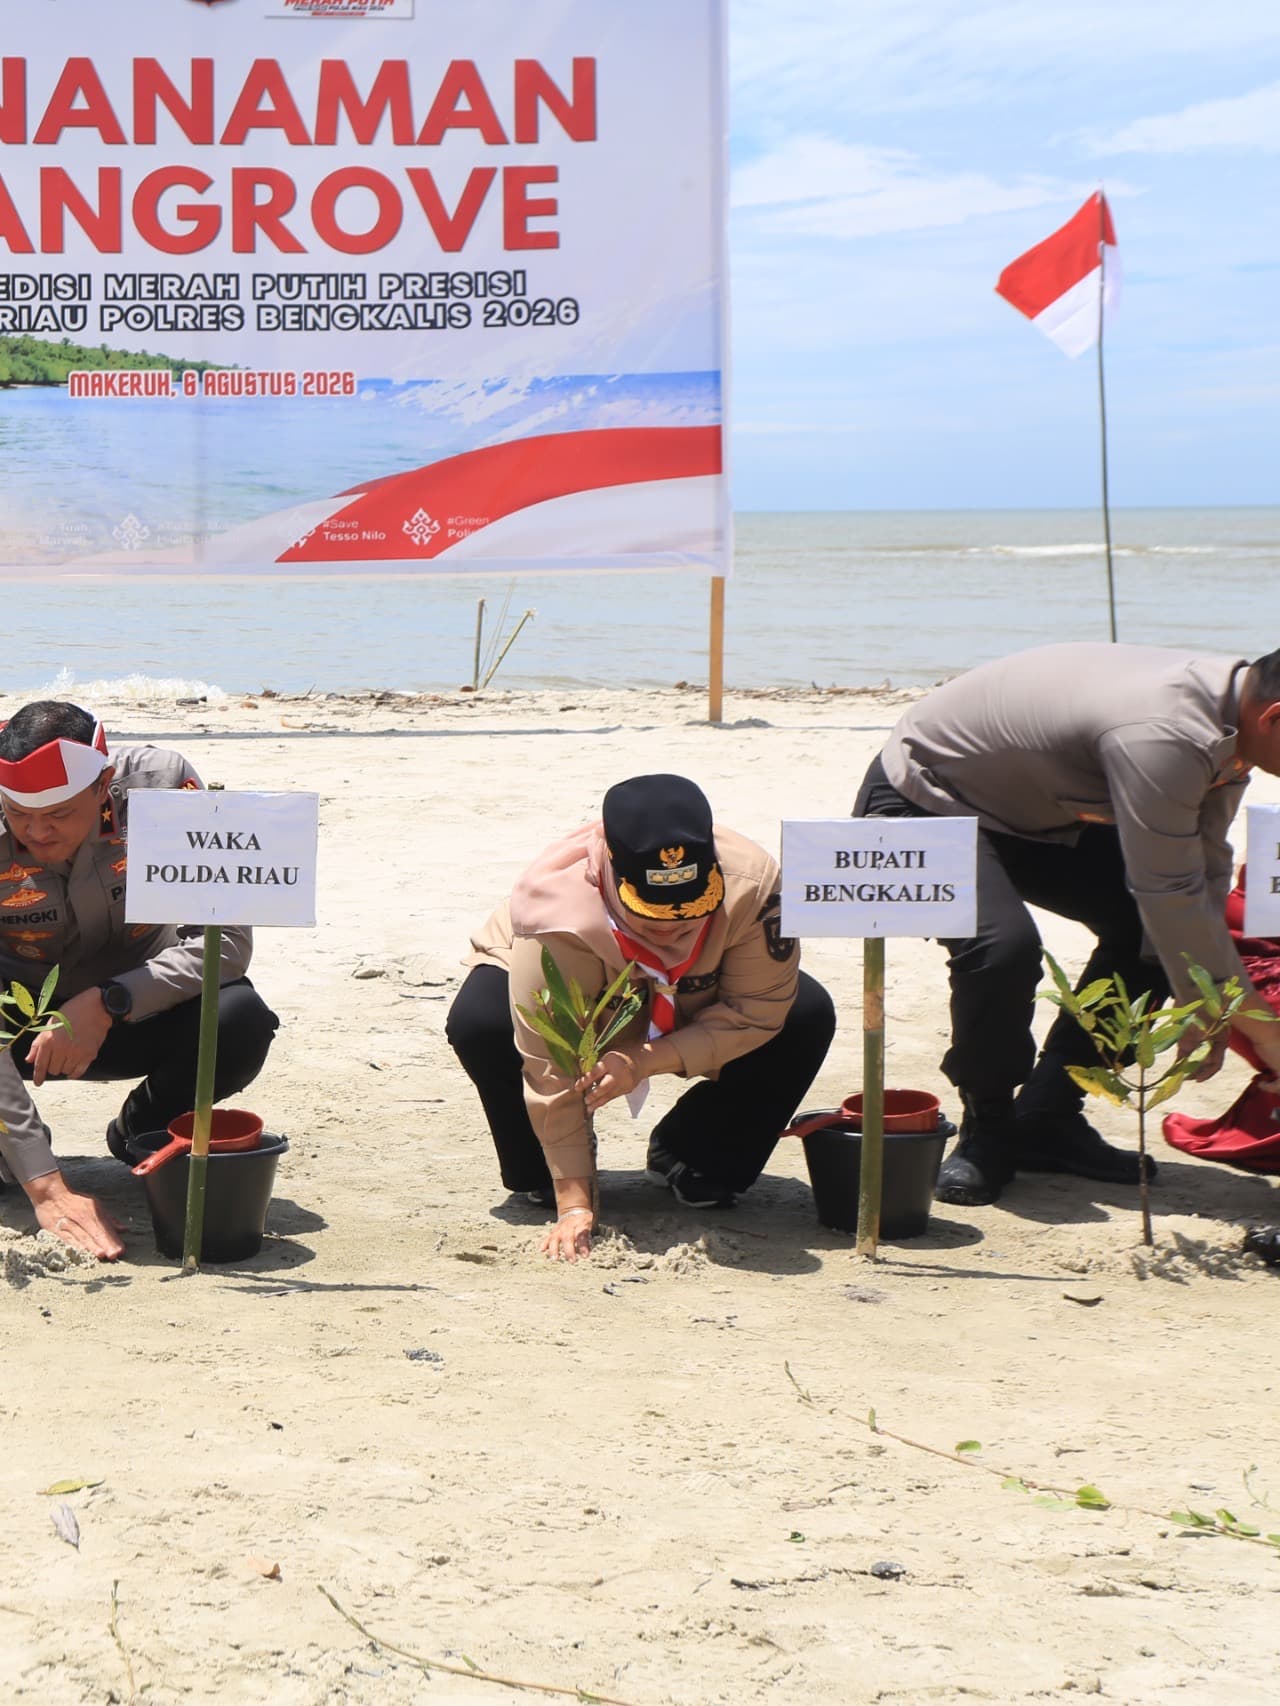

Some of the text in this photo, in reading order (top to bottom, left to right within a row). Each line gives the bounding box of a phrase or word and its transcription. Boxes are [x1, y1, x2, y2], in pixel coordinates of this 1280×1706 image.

[103, 273, 240, 300] MERAH
[252, 273, 367, 300] PUTIH
[379, 270, 527, 299] PRESISI
[100, 304, 245, 332] POLRES
[256, 302, 472, 331] BENGKALIS
[483, 298, 580, 327] 2026
[69, 371, 356, 397] MAKERUH, 6 AGUSTUS 2026
[324, 530, 386, 541] Tesso Nilo
[186, 831, 262, 851] WAKA
[835, 850, 926, 869] BUPATI
[145, 864, 300, 885] POLDA RIAU
[804, 883, 955, 902] BENGKALIS
